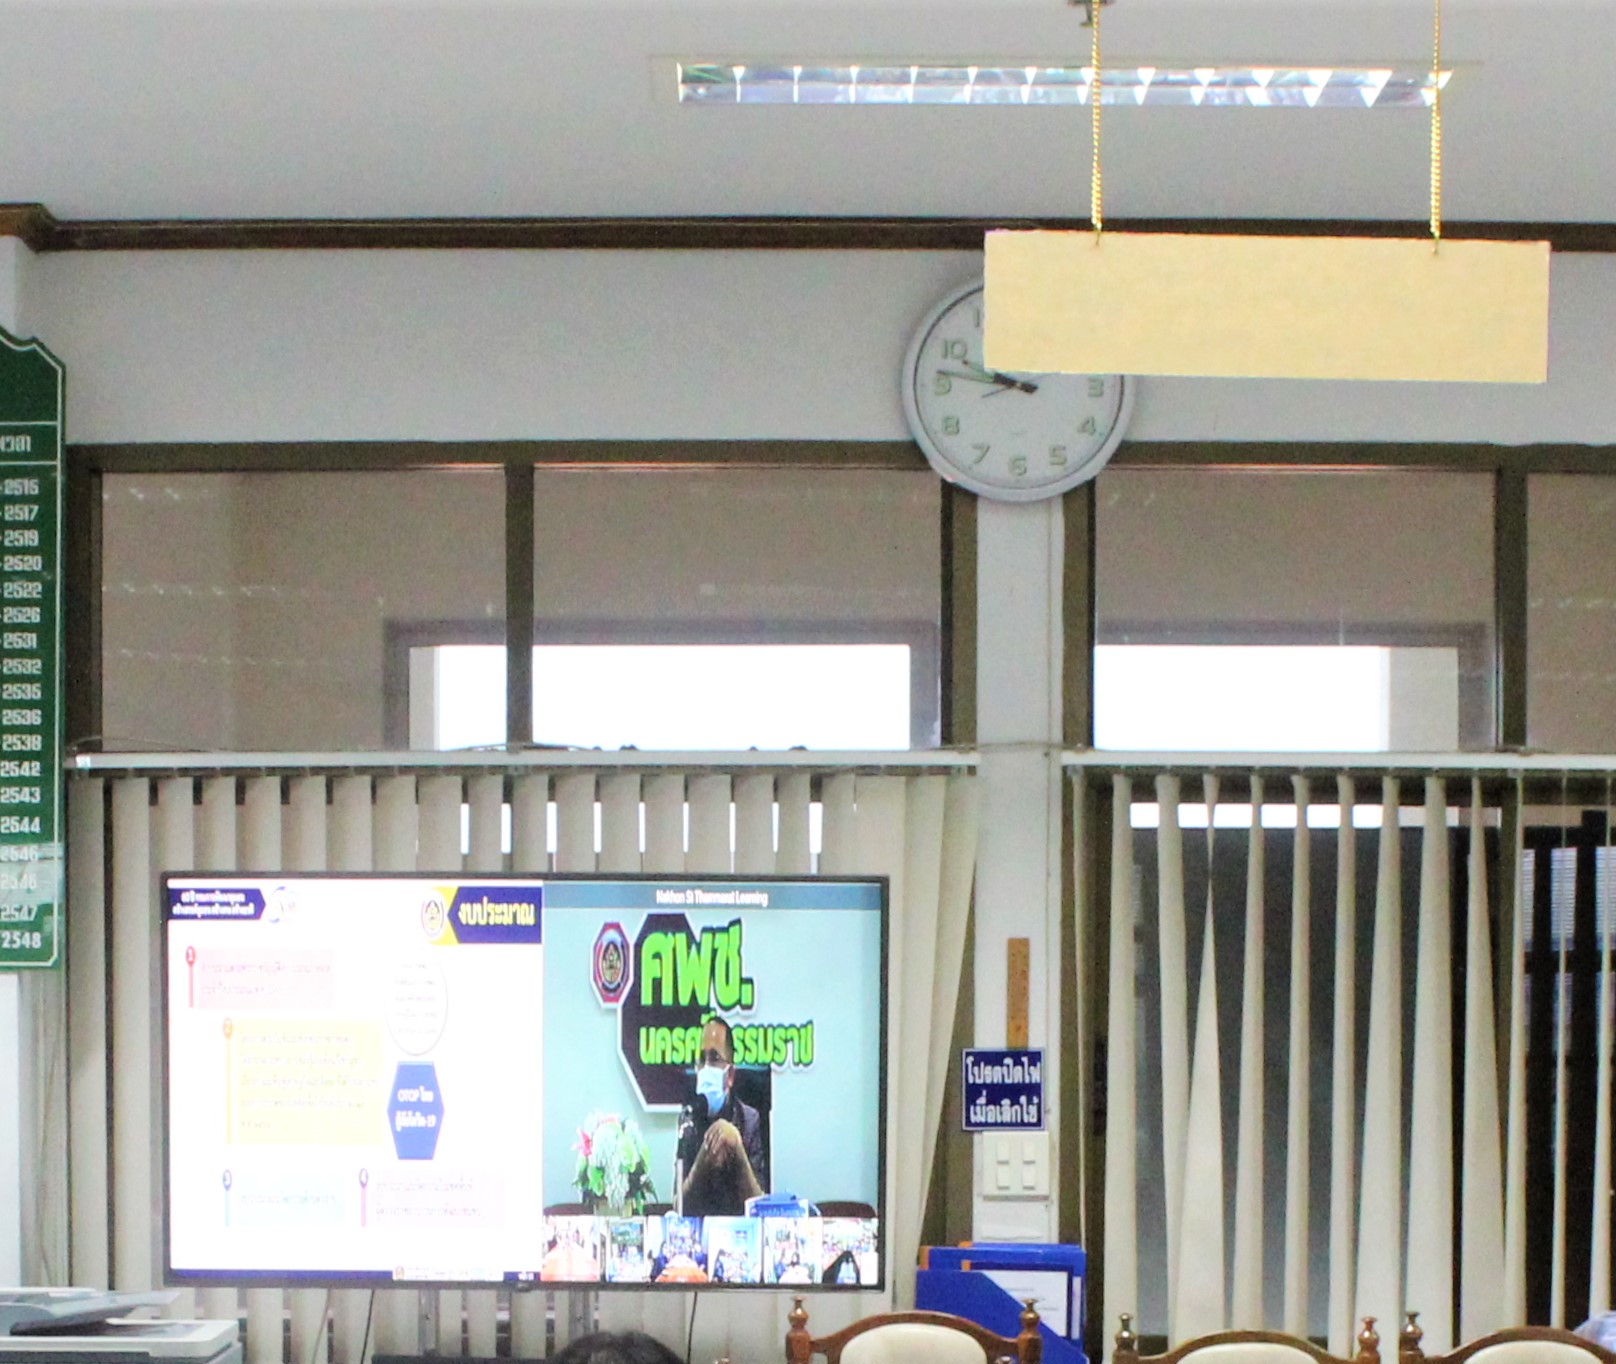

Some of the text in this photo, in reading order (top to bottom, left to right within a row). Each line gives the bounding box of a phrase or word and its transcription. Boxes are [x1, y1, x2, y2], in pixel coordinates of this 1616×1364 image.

[941, 340, 968, 359] 10
[1087, 378, 1104, 398] 3
[943, 416, 960, 435] 8
[1077, 416, 1096, 435] 4
[973, 445, 990, 464] 7
[1049, 445, 1067, 466] 5
[1008, 455, 1027, 477] 6
[458, 896, 536, 925] งบประมาณ
[640, 919, 754, 1007] ศพช.
[966, 1055, 1041, 1084] โปรดปิดไฟ
[969, 1089, 1039, 1124] เมื่อเลิกใช้
